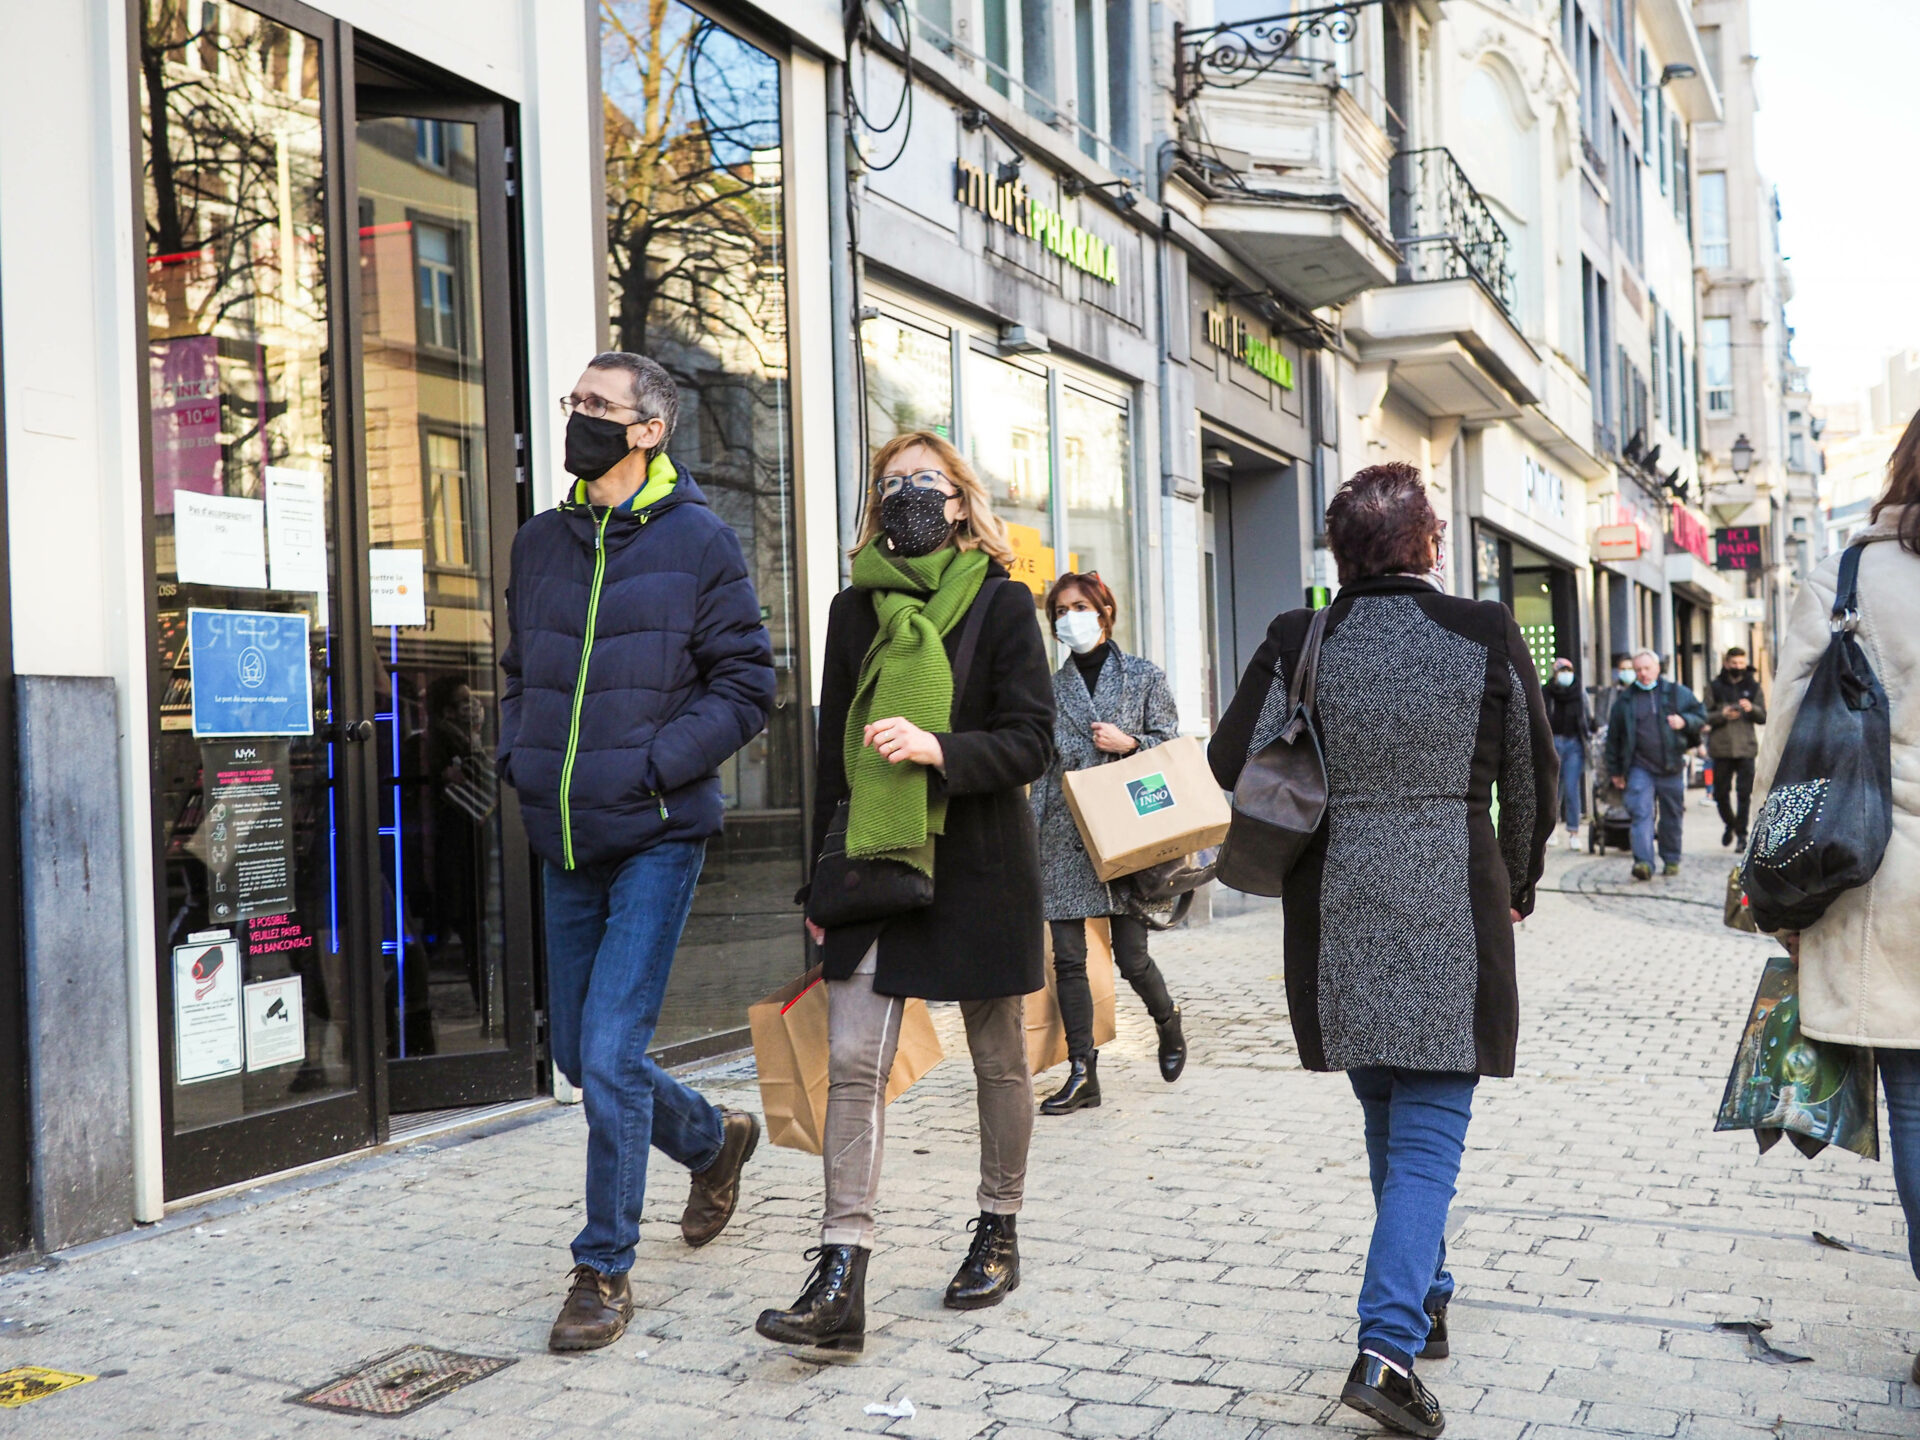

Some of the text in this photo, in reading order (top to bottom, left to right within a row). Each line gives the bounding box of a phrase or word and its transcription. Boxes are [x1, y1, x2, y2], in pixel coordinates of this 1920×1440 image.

[1205, 308, 1294, 391] mltiPHARMA
[1727, 529, 1750, 542] ICI
[1717, 542, 1760, 557] PARIS
[1729, 557, 1750, 569] XL
[158, 584, 177, 596] OSS
[234, 748, 256, 761] NYX
[1139, 789, 1169, 807] INNO
[249, 914, 291, 929] SI POSSIBLE,
[249, 925, 302, 942] VEUILLEZ PAYER
[249, 936, 313, 956] PAR BANCONTACT
